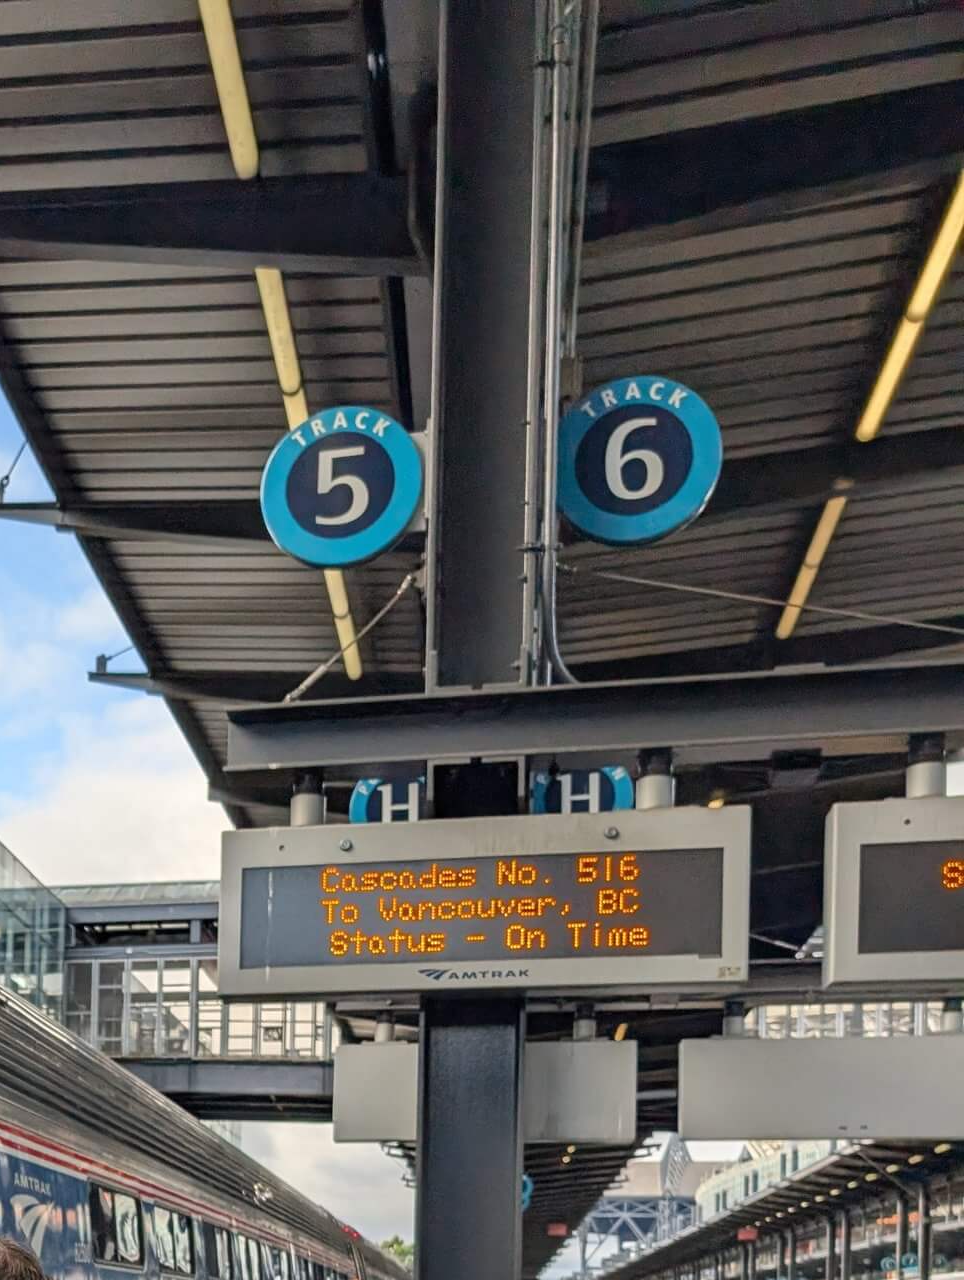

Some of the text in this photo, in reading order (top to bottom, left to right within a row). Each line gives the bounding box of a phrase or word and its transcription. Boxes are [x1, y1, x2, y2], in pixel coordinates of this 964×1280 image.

[580, 382, 689, 417] TRACK
[291, 411, 392, 447] TRACK
[605, 417, 665, 500] 6
[315, 445, 370, 526] 5
[321, 854, 640, 893] Cascades No. 516
[321, 888, 639, 924] To Vancouver, BC
[330, 928, 446, 955] Status
[505, 923, 546, 950] On
[567, 922, 649, 949] Time
[449, 969, 530, 980] AMTRAK
[13, 1171, 52, 1198] AMTRAK
